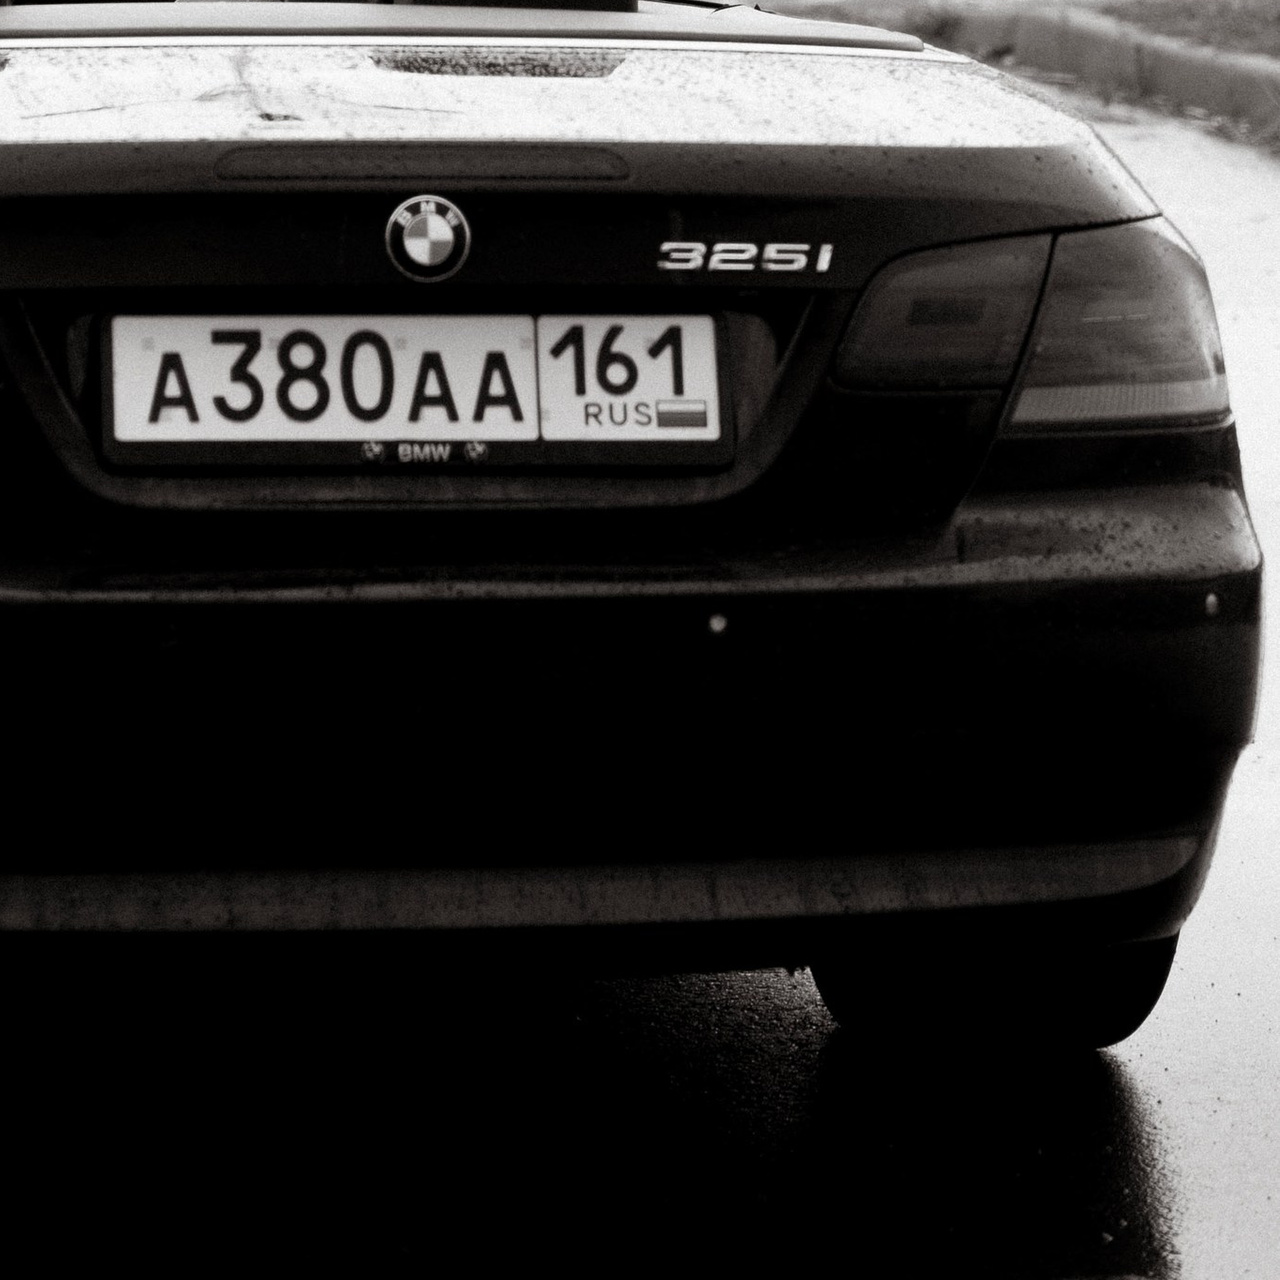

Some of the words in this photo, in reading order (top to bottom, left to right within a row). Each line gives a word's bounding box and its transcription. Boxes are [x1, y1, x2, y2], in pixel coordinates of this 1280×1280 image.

[396, 200, 461, 228] BMW
[550, 325, 684, 396] 161
[584, 402, 653, 426] RUS
[397, 442, 451, 462] BMW
